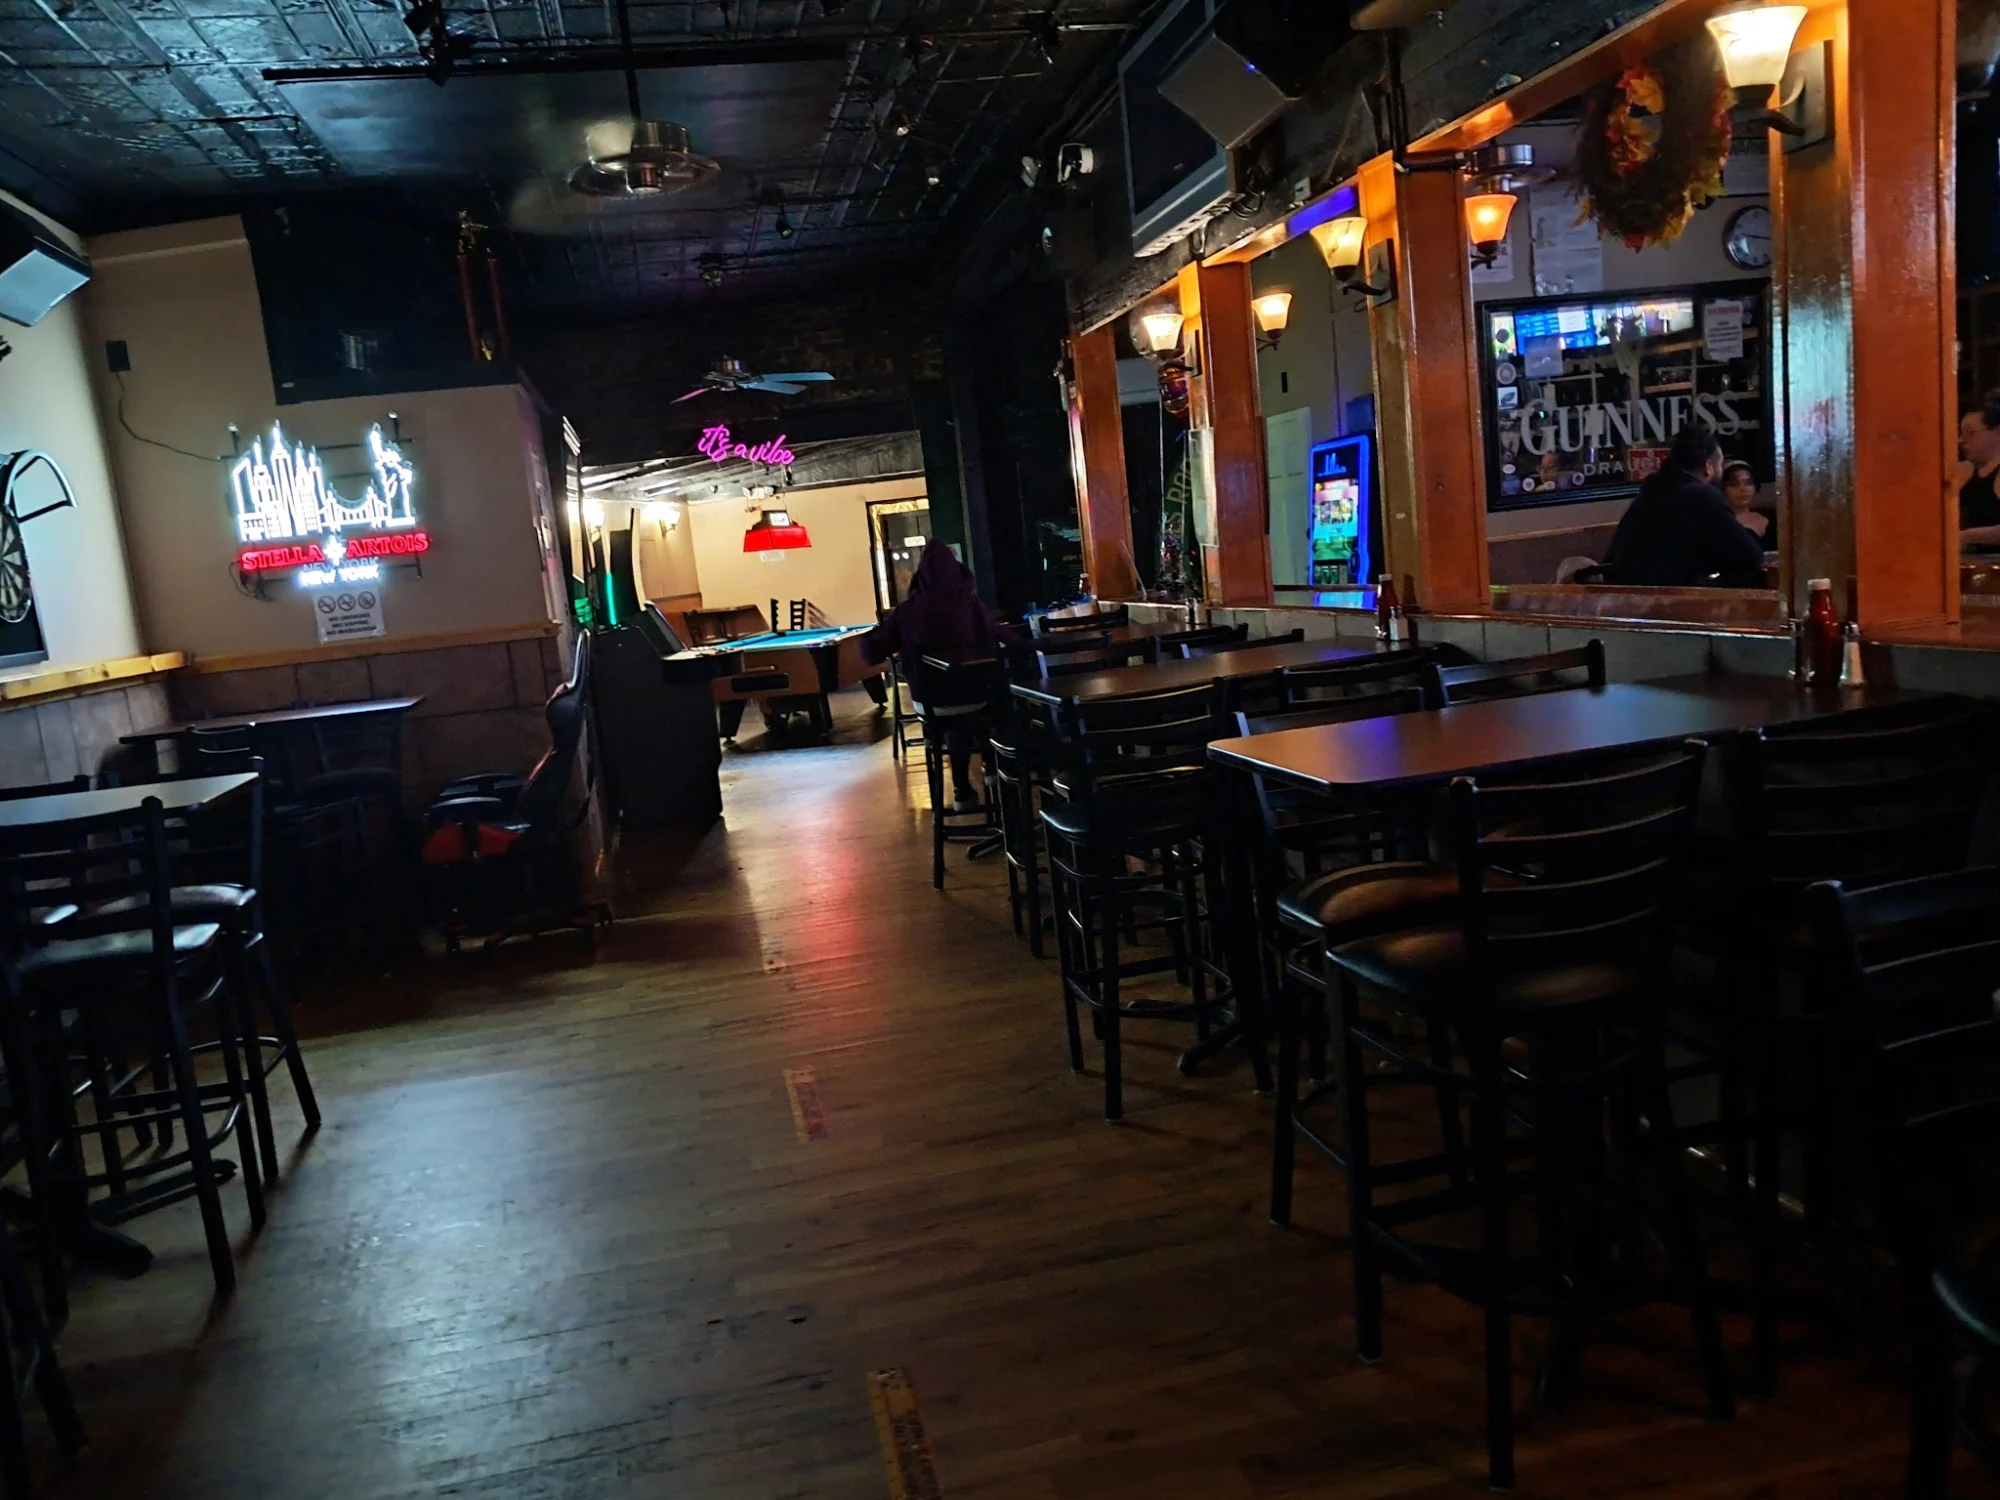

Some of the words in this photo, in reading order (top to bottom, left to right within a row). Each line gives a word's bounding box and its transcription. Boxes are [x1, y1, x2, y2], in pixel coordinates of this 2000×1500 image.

[1519, 391, 1741, 456] GUINNESS
[734, 443, 747, 458] a
[749, 434, 795, 465] vibe
[241, 545, 326, 571] STELLA
[346, 533, 430, 558] ARTOIS
[300, 568, 336, 586] NEW
[338, 563, 380, 582] YORK
